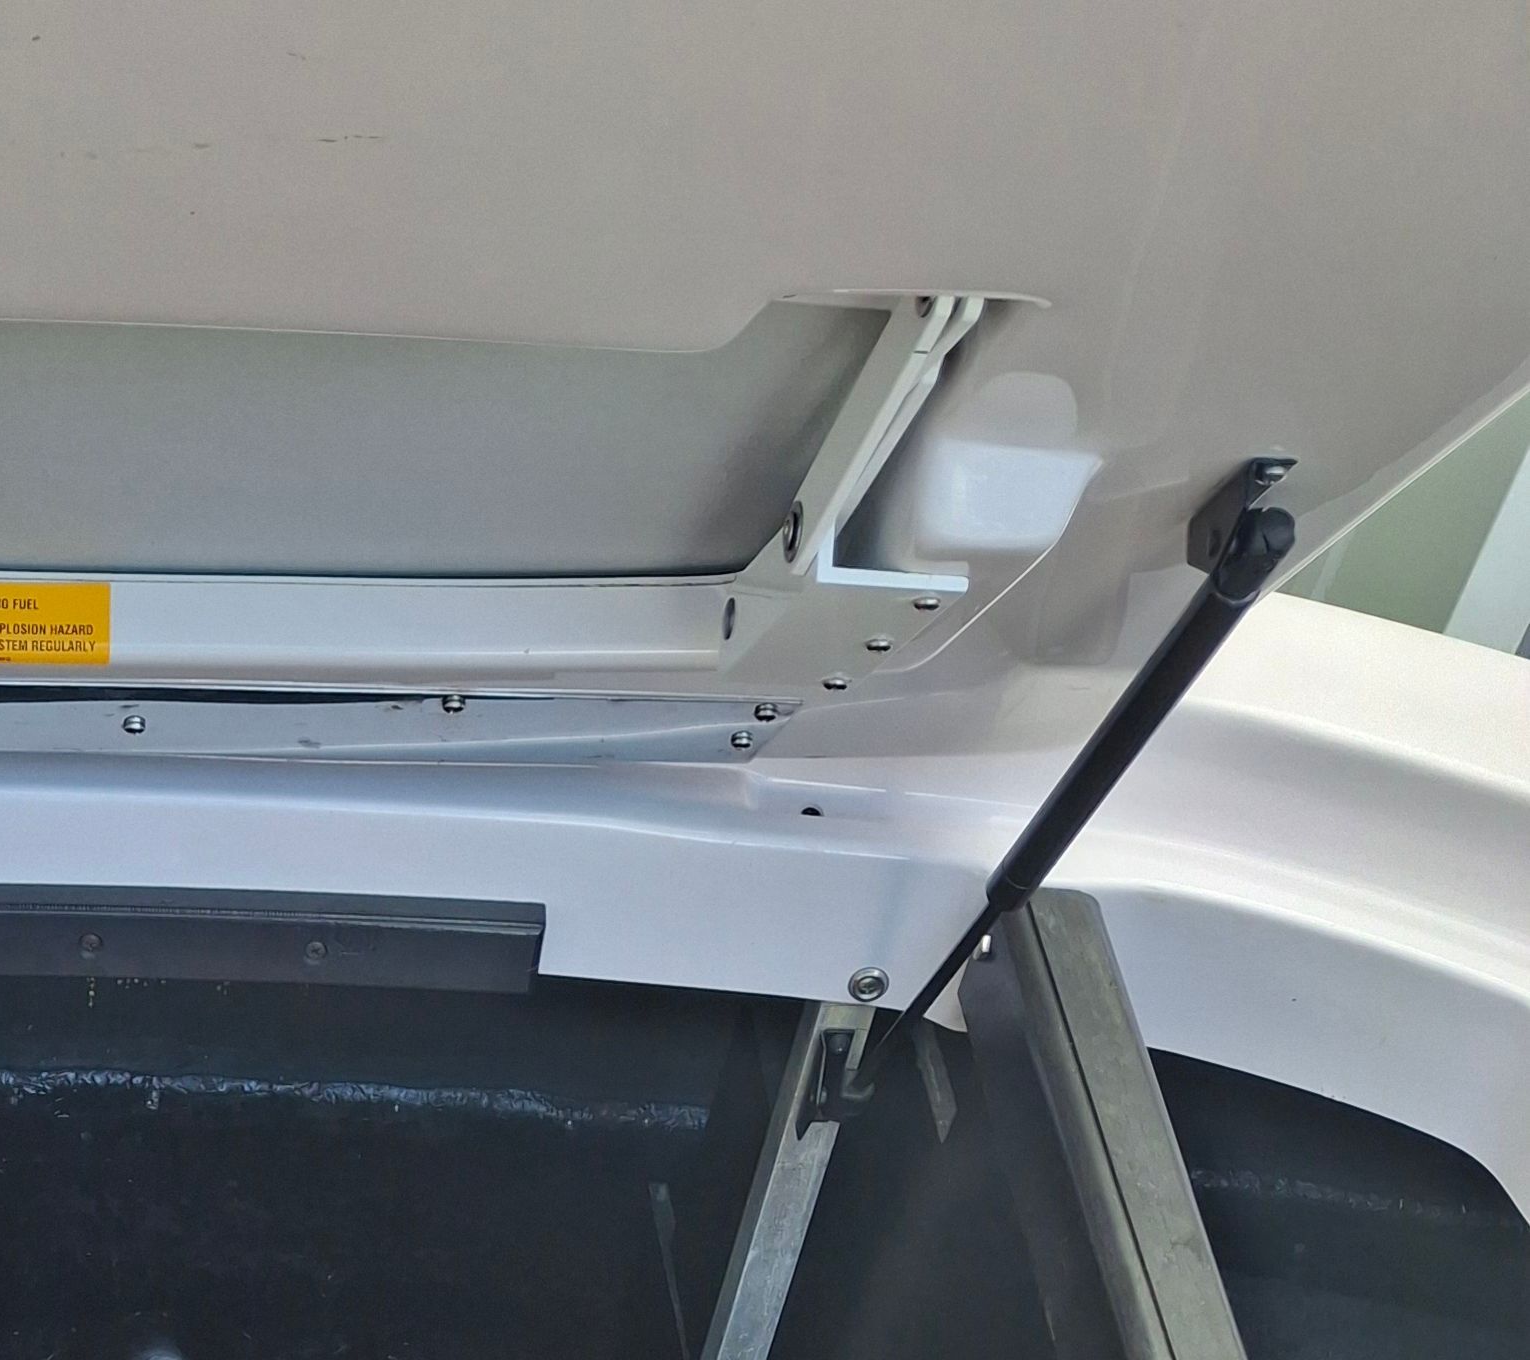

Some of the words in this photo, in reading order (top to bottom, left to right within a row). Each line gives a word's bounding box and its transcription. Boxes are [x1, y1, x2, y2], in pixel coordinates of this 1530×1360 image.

[12, 599, 39, 610] FUEL
[50, 624, 93, 636] HAZARD
[31, 640, 96, 652] REGULARLY
